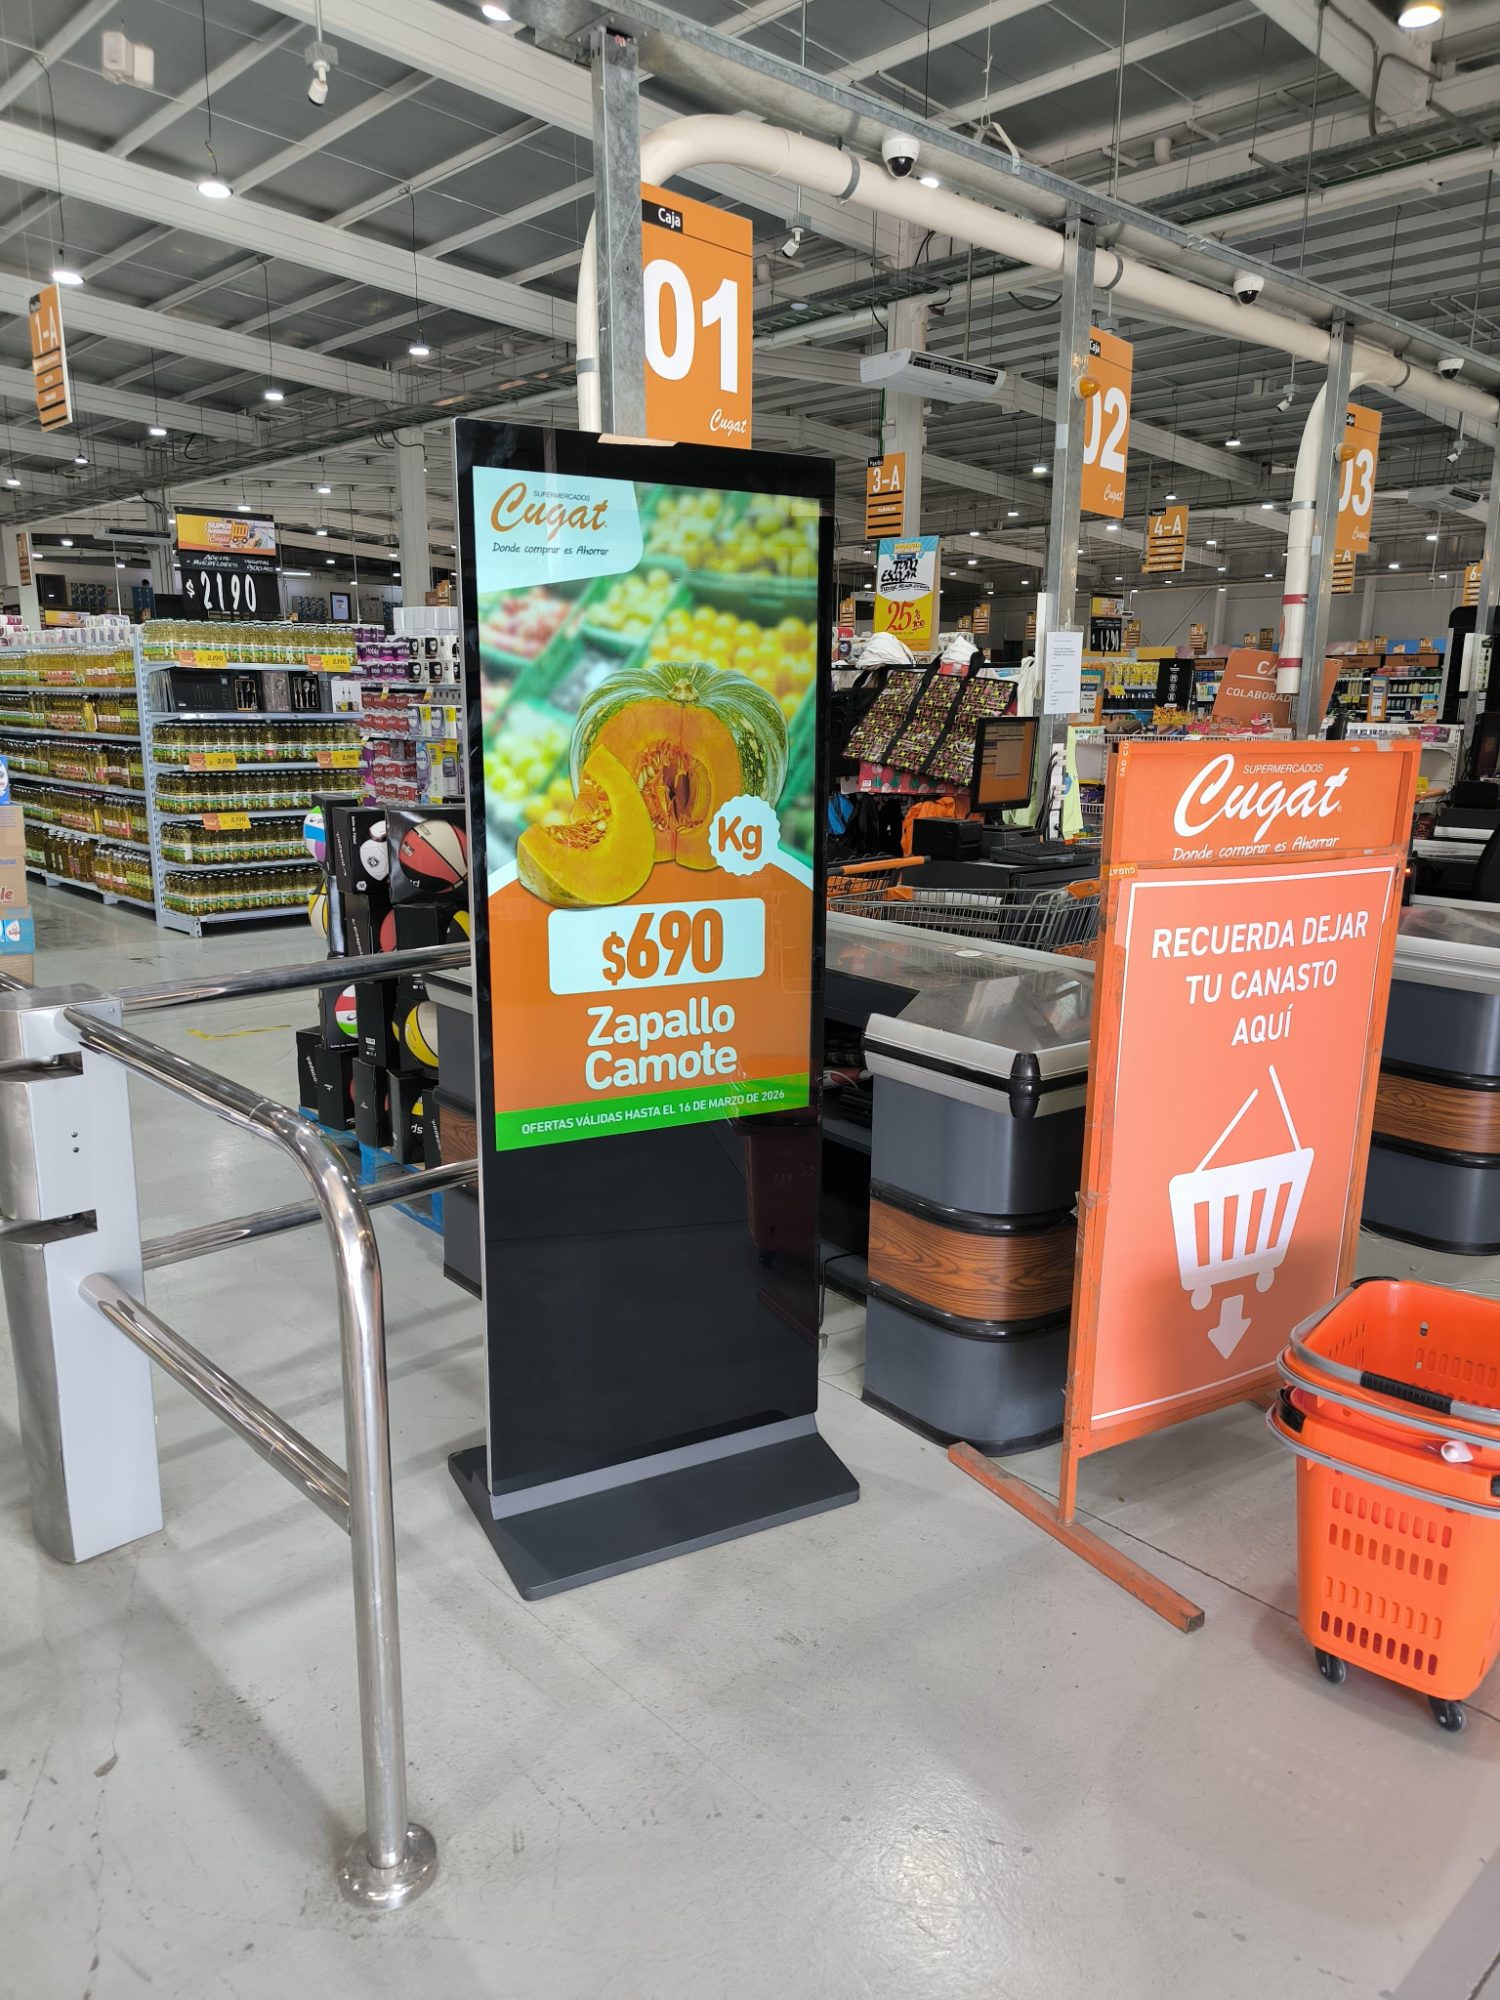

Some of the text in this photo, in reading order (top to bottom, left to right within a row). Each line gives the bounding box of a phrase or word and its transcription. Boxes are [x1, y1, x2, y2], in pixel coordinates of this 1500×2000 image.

[657, 207, 682, 229] Caja
[643, 258, 738, 394] 01
[708, 408, 747, 437] Cugat
[533, 490, 591, 502] SUPERMERCADOS
[872, 464, 901, 494] 3-A
[1103, 483, 1124, 504] Cugat
[491, 482, 609, 542] Cugat
[1153, 514, 1182, 536] 4-A
[492, 542, 610, 556] Donde comprar es Ahorrar
[185, 570, 257, 613] $ 2190
[886, 601, 915, 631] 25
[1243, 763, 1325, 775] SUPERMERCADOS
[1173, 753, 1350, 843] Cugat
[717, 815, 764, 860] Kg
[1172, 836, 1340, 861] Donde comprar es Ahorrar
[602, 908, 724, 986] $690
[1151, 910, 1369, 960] RECUERDA DEJAR
[1186, 959, 1338, 1005] TU CANASTO
[586, 996, 736, 1051] Zapallo
[1230, 1003, 1293, 1047] AQUÍ
[584, 1041, 738, 1091] Camote
[522, 1089, 785, 1135] OFERTAS VÁLIDAS HASTA EL 16 DE MARZO DE 2026
